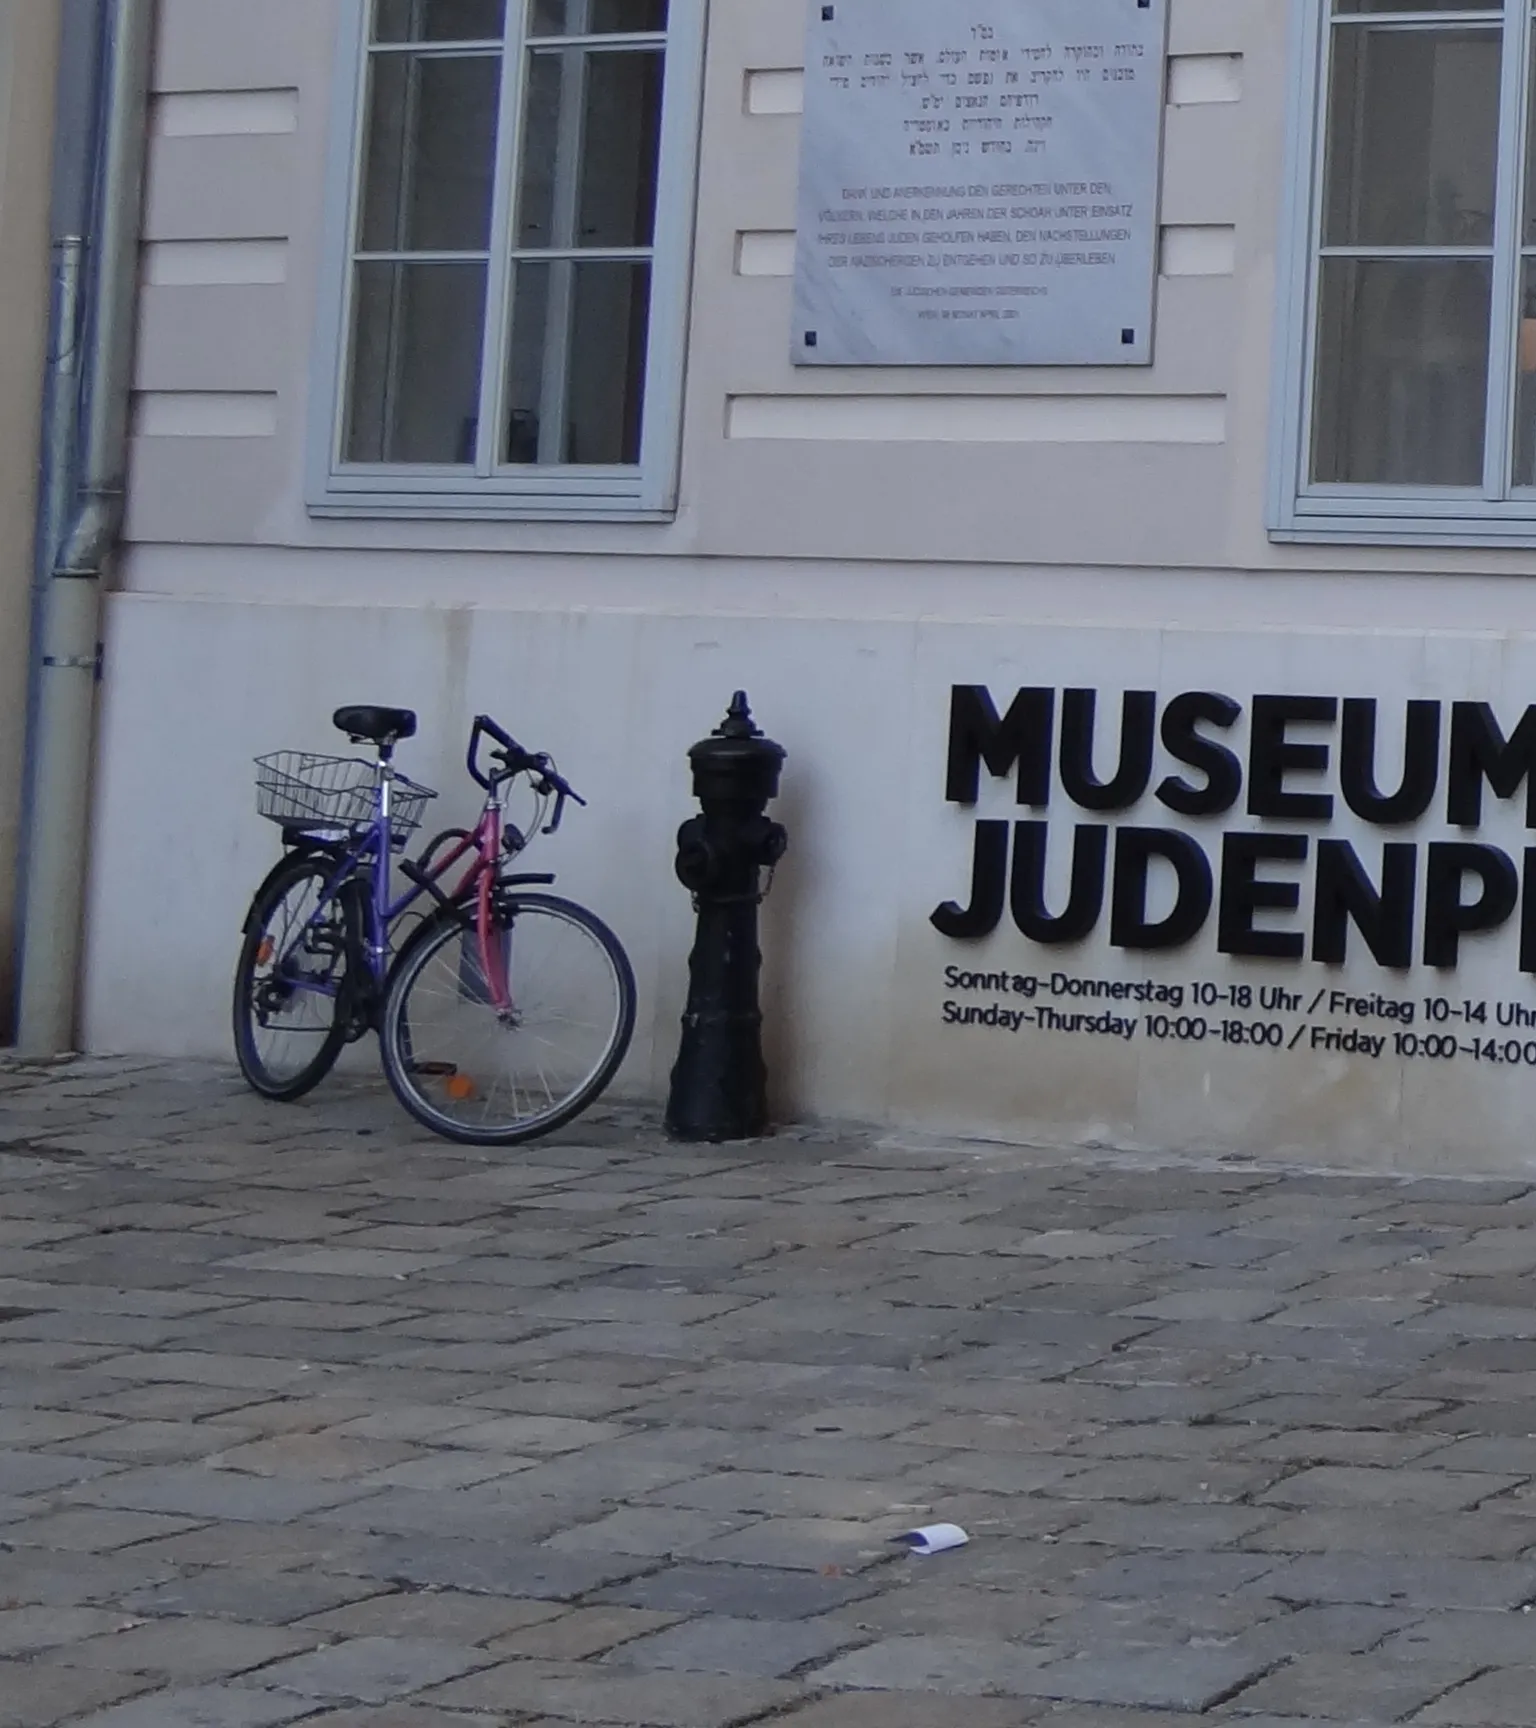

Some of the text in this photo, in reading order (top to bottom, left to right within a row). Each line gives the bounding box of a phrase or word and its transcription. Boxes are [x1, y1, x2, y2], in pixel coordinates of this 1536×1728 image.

[968, 184, 989, 198] DEN
[1054, 183, 1087, 196] UNTER
[923, 208, 943, 221] DEN
[1016, 229, 1036, 243] DEN
[1189, 981, 1253, 1010] 10-18
[1259, 985, 1303, 1012] Uhr
[1306, 988, 1326, 1015] /
[1328, 990, 1416, 1026] Freitag
[1423, 997, 1488, 1025] 10-14
[1286, 1023, 1307, 1050] /
[1310, 1026, 1387, 1059] Friday
